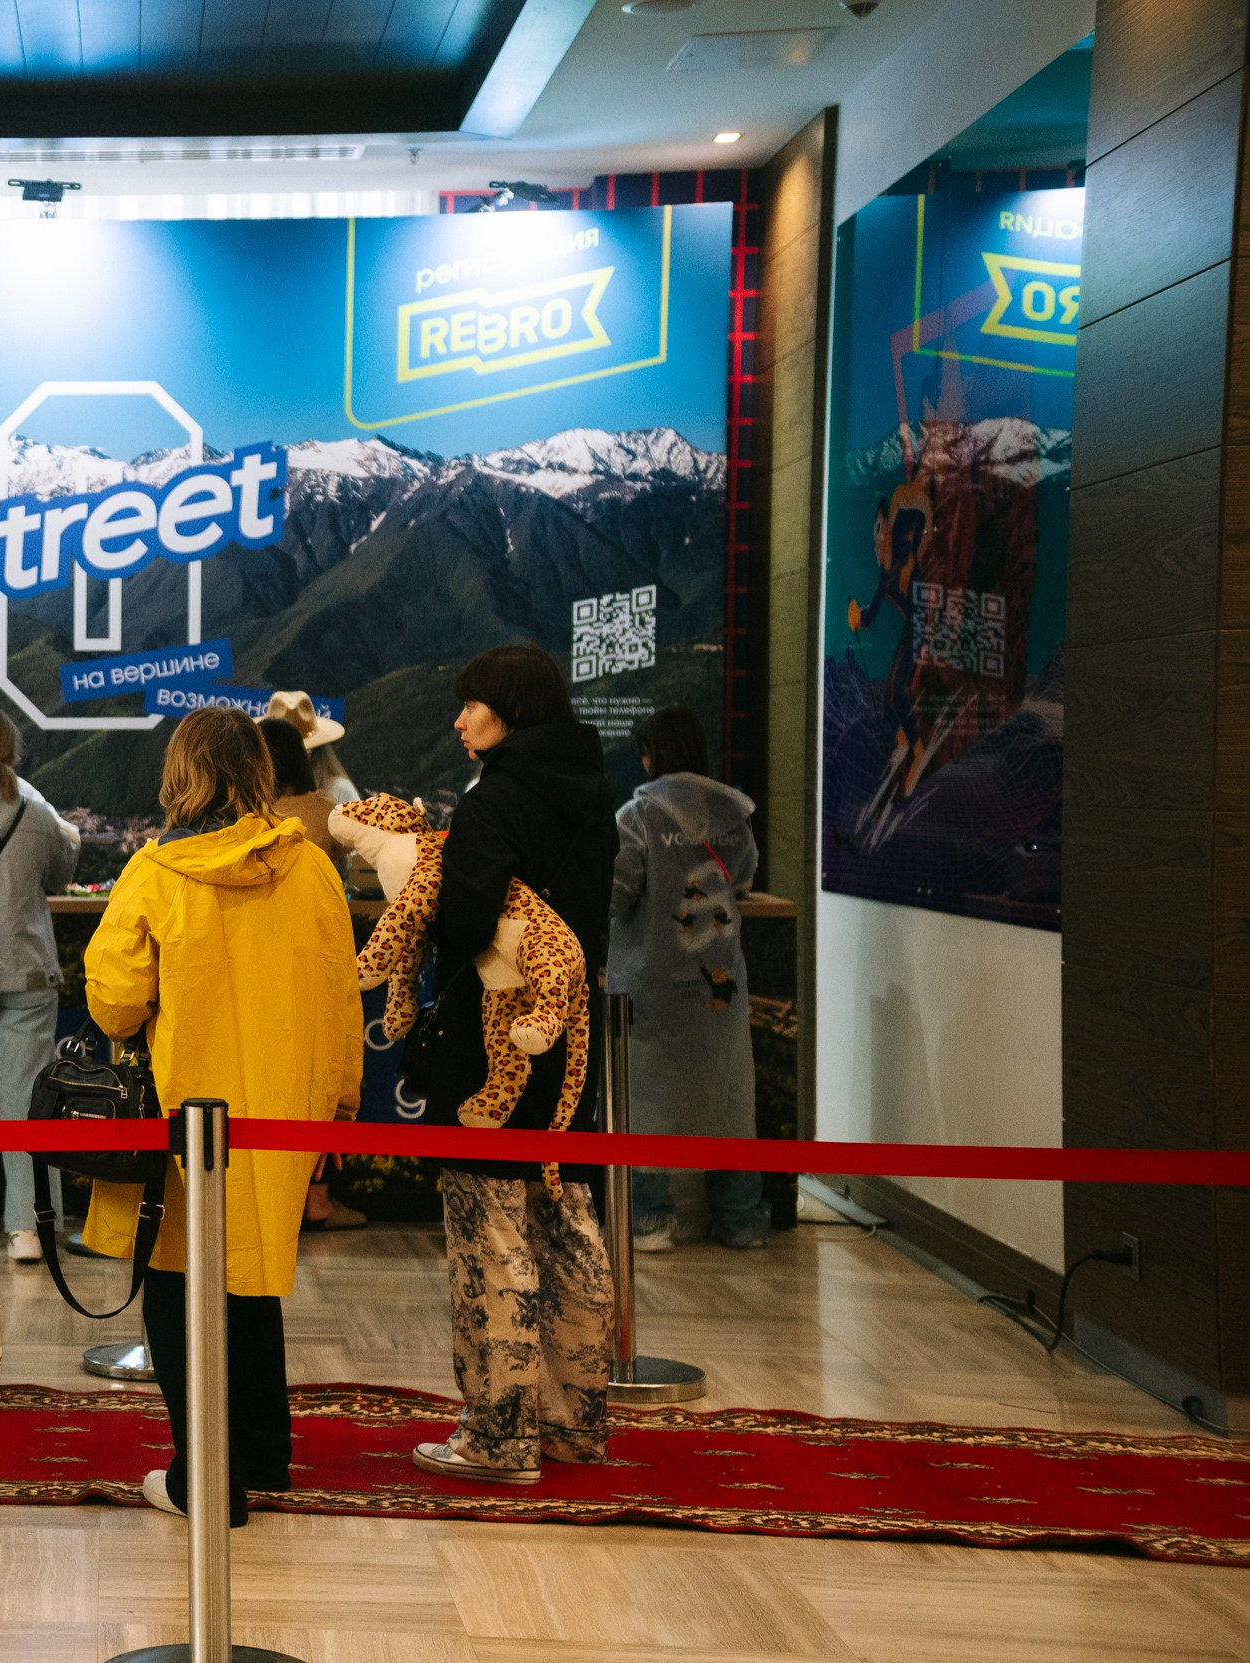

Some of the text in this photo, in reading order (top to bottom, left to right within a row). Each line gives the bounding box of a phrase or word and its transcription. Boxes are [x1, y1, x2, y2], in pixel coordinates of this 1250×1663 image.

[420, 298, 572, 359] REBRO
[73, 651, 220, 691] на вершине
